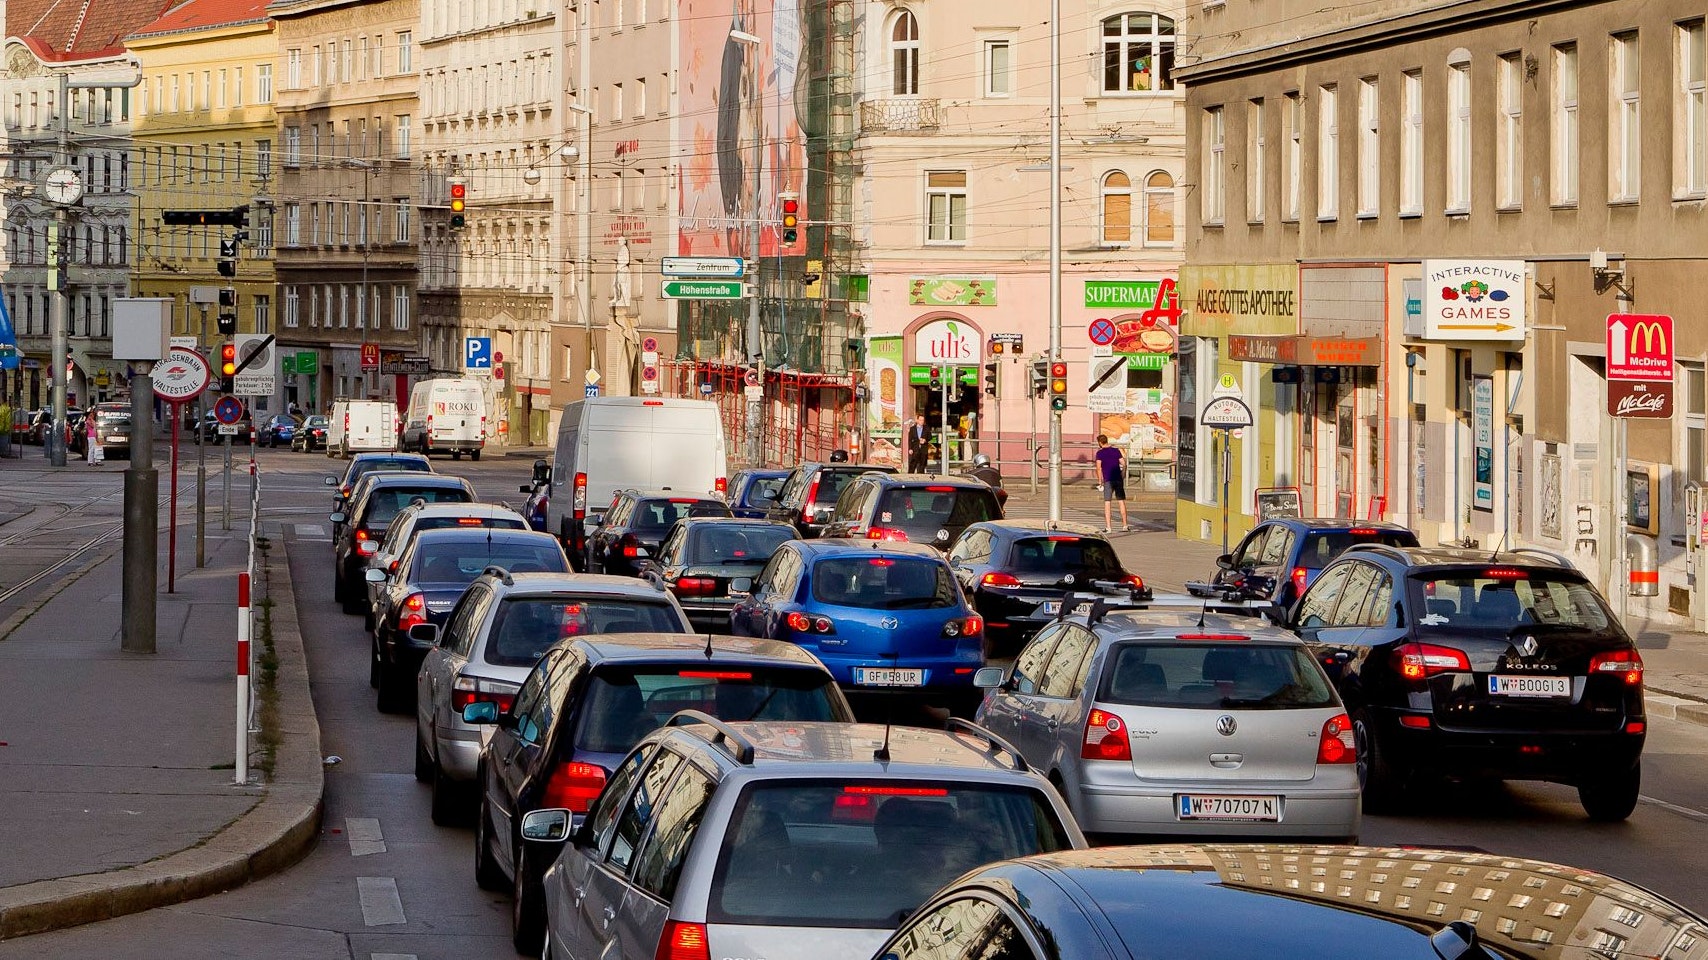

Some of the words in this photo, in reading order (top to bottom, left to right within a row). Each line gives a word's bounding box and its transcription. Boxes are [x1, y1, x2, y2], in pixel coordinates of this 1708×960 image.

[696, 262, 729, 271] Zentrum
[1431, 266, 1521, 283] INTERACTIVE
[680, 285, 730, 294] Höhenstraße
[1197, 290, 1217, 313] AUGE
[1219, 290, 1248, 314] GOTTES
[1250, 290, 1293, 316] APOTHEKE
[1441, 307, 1510, 319] GAMES
[469, 340, 481, 358] P
[931, 328, 970, 358] uli's
[1630, 357, 1667, 367] McDrive
[154, 380, 199, 394] HALTESTELLE
[448, 402, 478, 411] ROKU
[1214, 401, 1242, 411] AUTOBUS
[1617, 393, 1665, 412] McCafé
[870, 672, 881, 681] GF
[889, 672, 901, 681] 58
[904, 672, 915, 682] UR
[1500, 678, 1510, 691] W
[1558, 680, 1564, 692] 3
[1192, 799, 1202, 812] W
[1215, 799, 1258, 814] 70707
[1264, 800, 1272, 815] N
